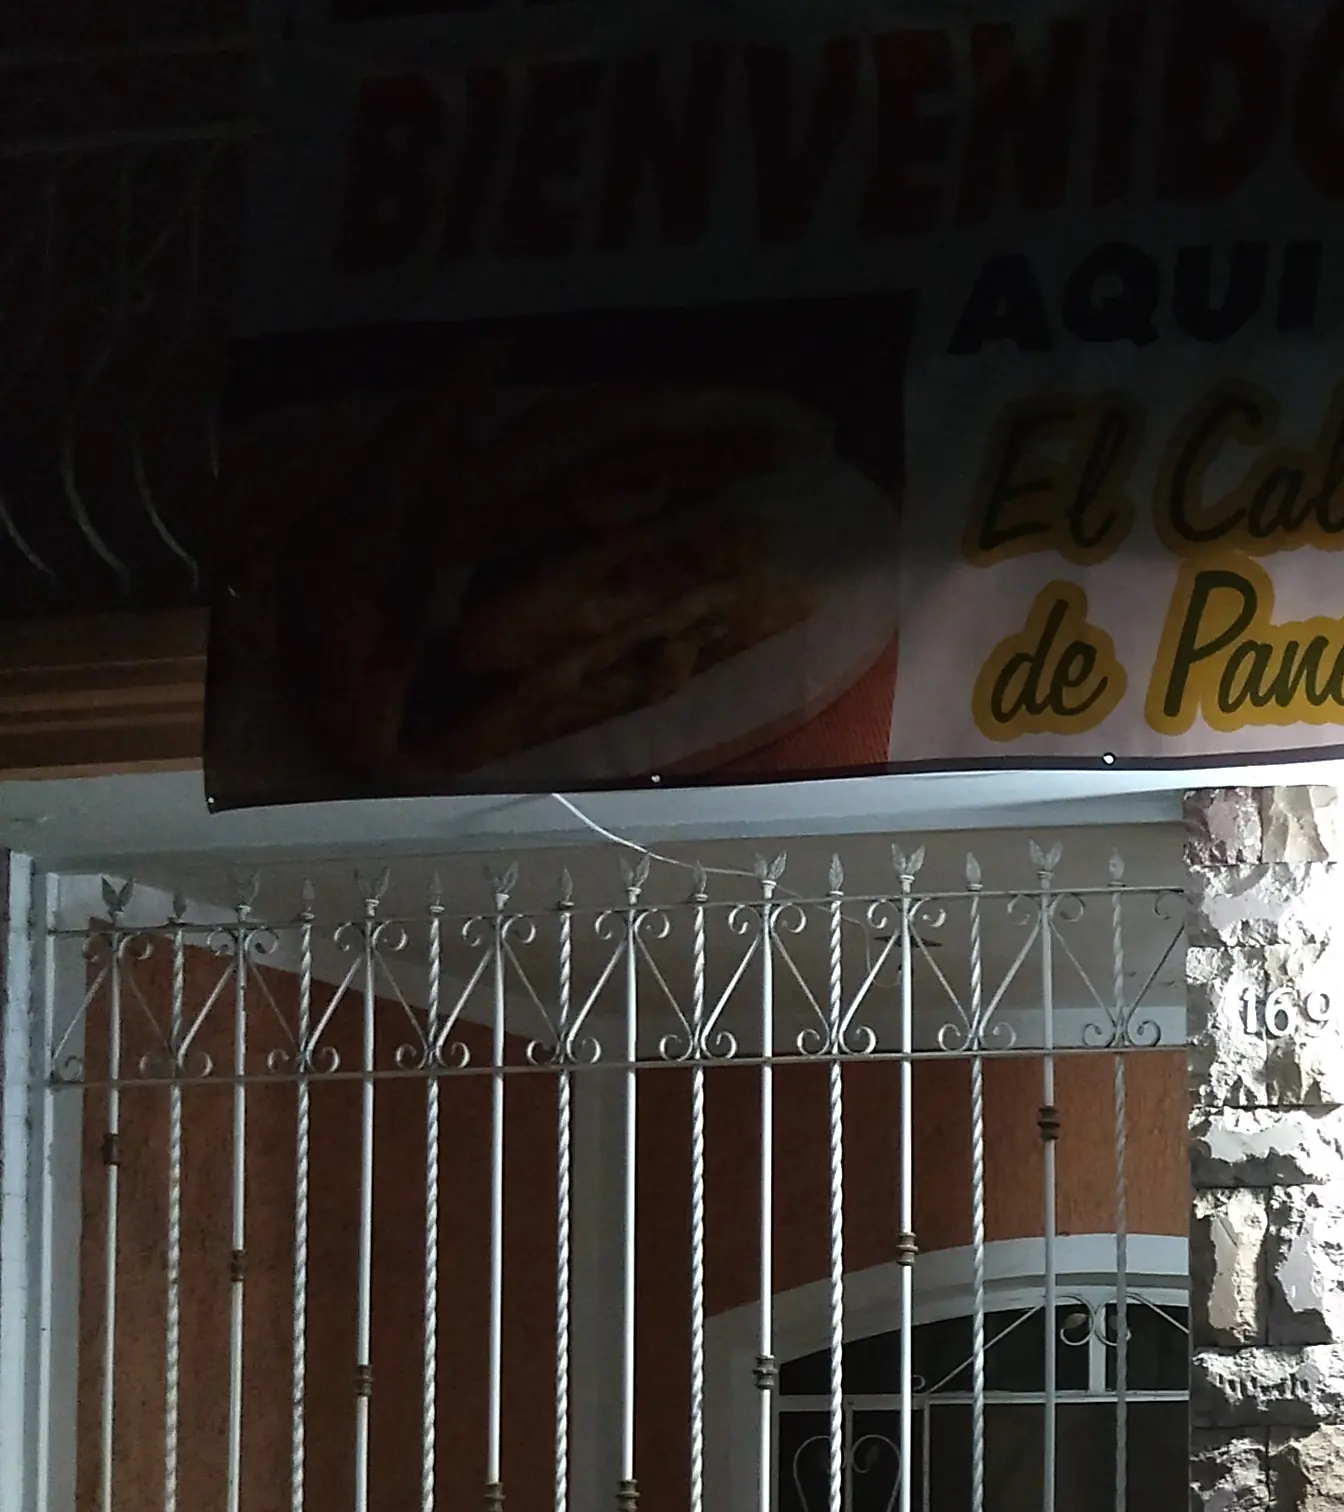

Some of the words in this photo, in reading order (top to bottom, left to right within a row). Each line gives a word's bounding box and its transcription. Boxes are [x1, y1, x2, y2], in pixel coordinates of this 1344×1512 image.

[947, 241, 1323, 355] AQUI
[977, 406, 1130, 551] El
[990, 598, 1109, 724] de
